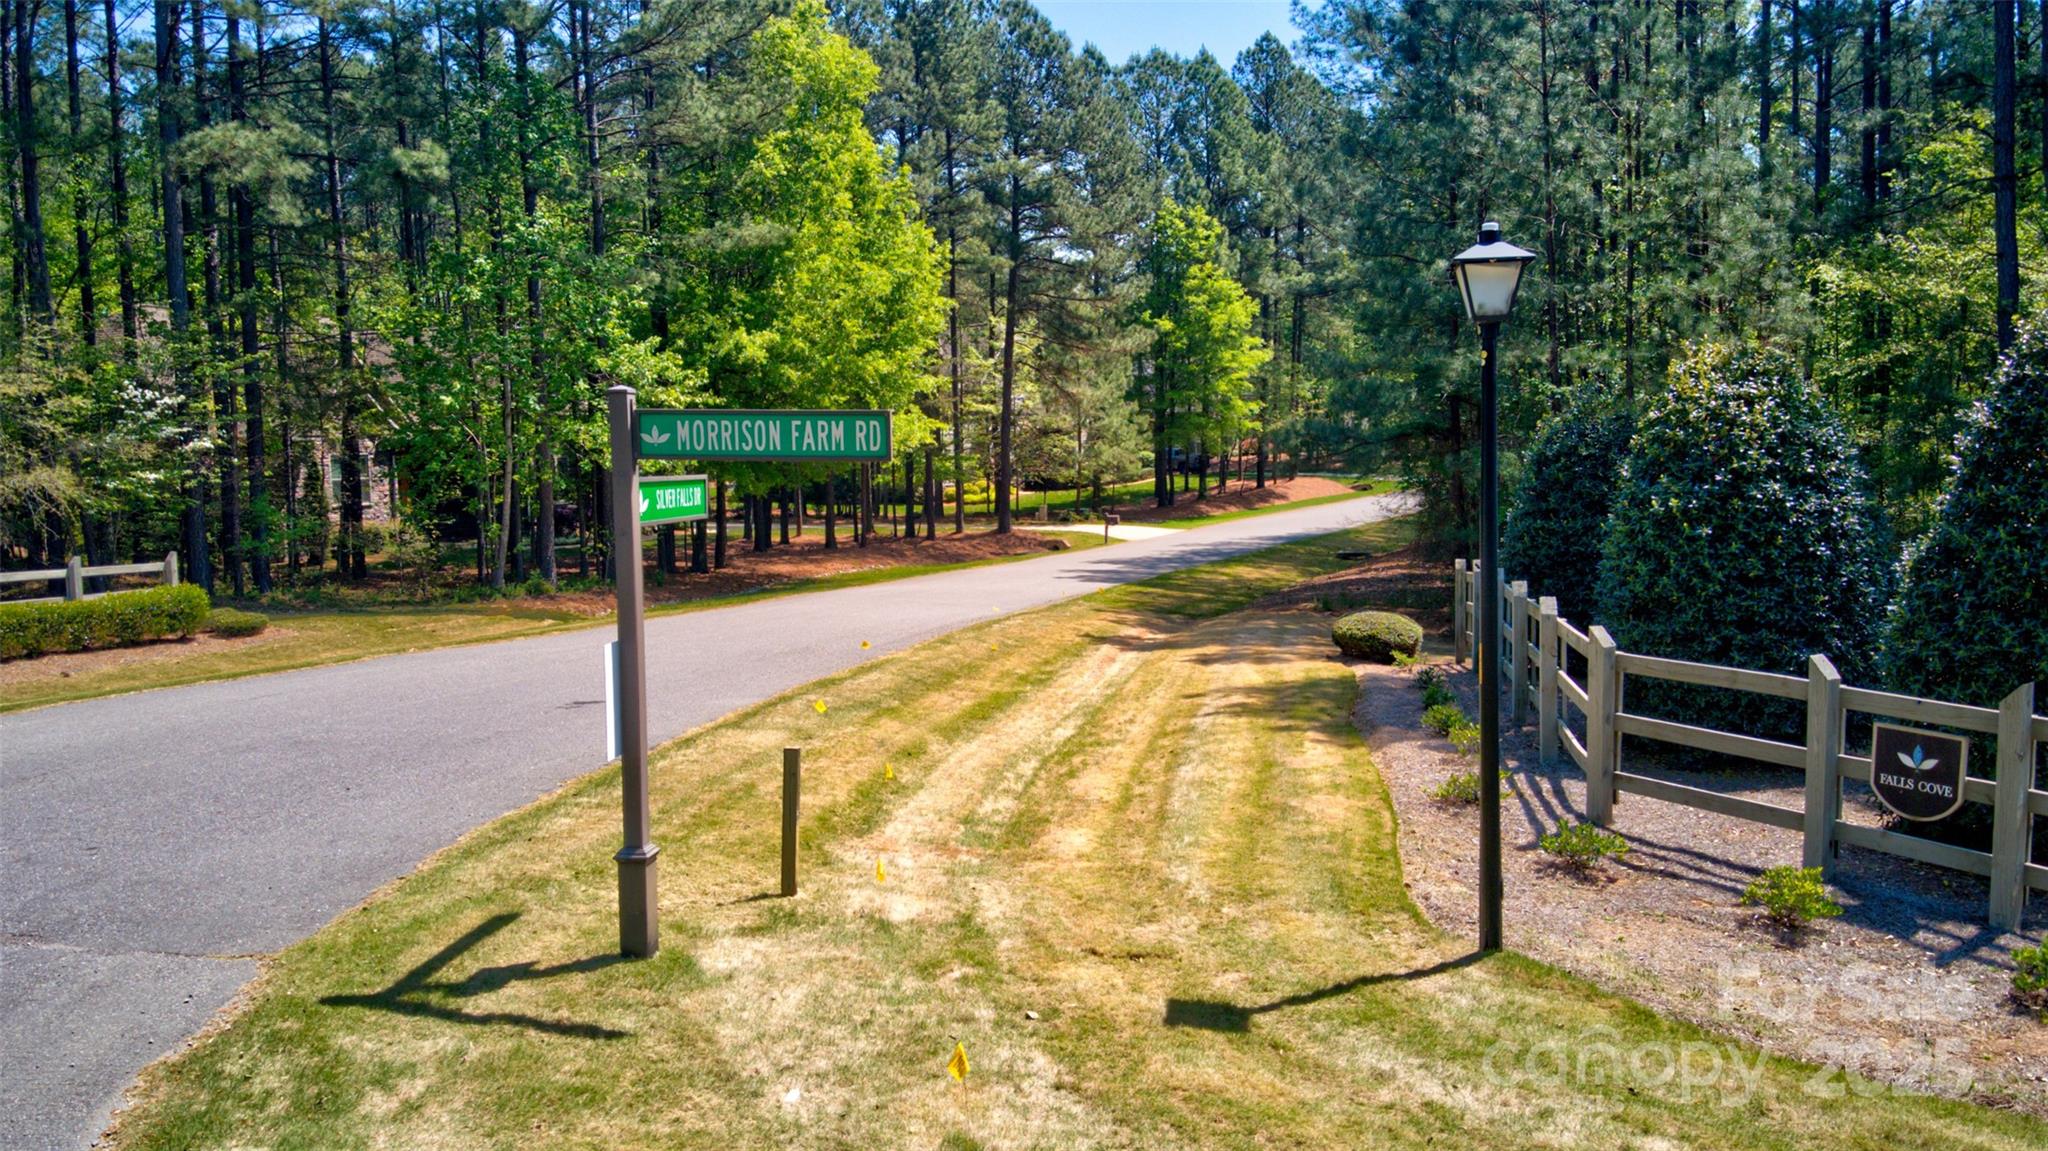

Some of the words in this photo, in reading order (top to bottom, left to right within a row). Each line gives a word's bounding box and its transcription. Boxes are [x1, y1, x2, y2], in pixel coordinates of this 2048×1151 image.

[676, 419, 781, 451] MORRISON
[791, 419, 845, 451] FARM
[855, 419, 881, 451] RD
[656, 488, 676, 510] SILVER
[676, 486, 693, 508] FALLS
[1880, 773, 1914, 790] FALLS
[1918, 781, 1953, 798] COVE
